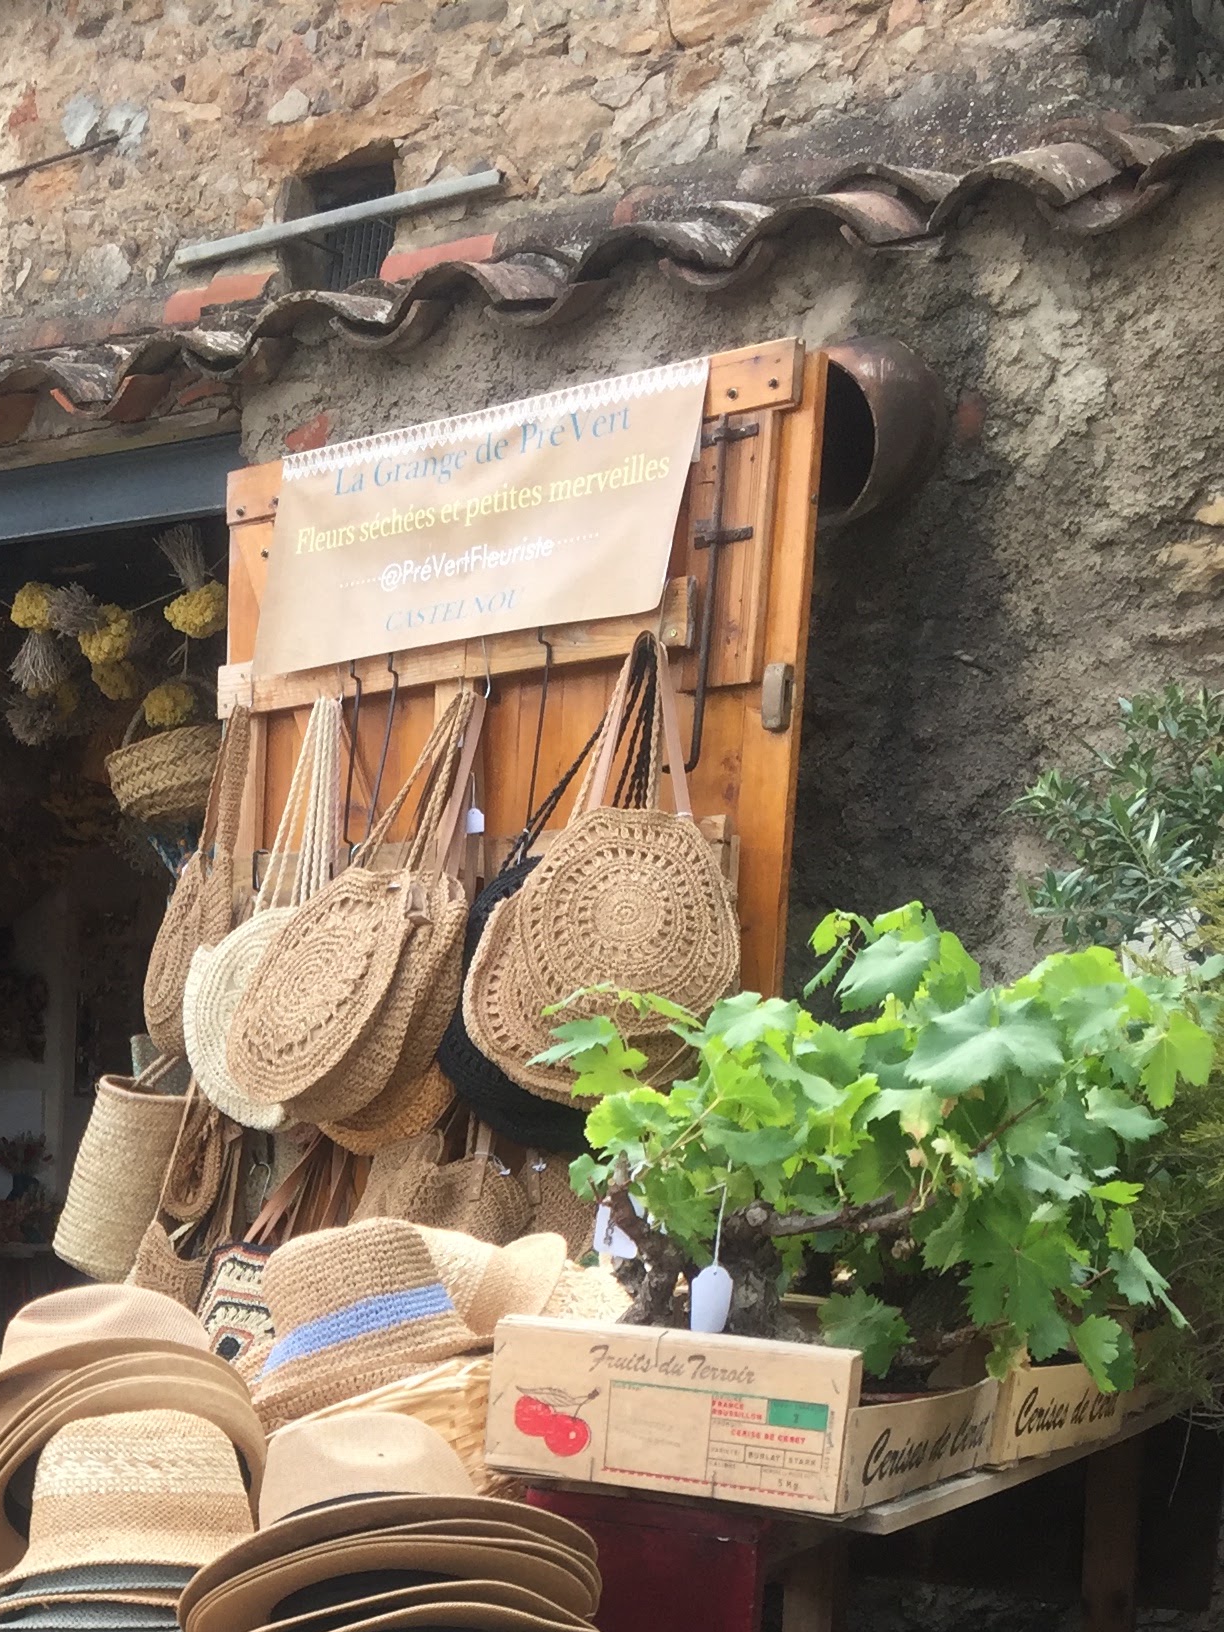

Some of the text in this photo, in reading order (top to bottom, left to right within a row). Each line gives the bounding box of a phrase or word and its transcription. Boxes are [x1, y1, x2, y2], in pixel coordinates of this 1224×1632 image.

[334, 467, 364, 496] La
[374, 448, 468, 484] Grange
[476, 432, 509, 465] de
[296, 453, 671, 554] Fleurs séchées et petites merveilles
[589, 1344, 756, 1385] Fruits du Terroir
[730, 1429, 762, 1440] CERISE
[1015, 1387, 1070, 1437] Cerises
[862, 1428, 928, 1487] Cerises
